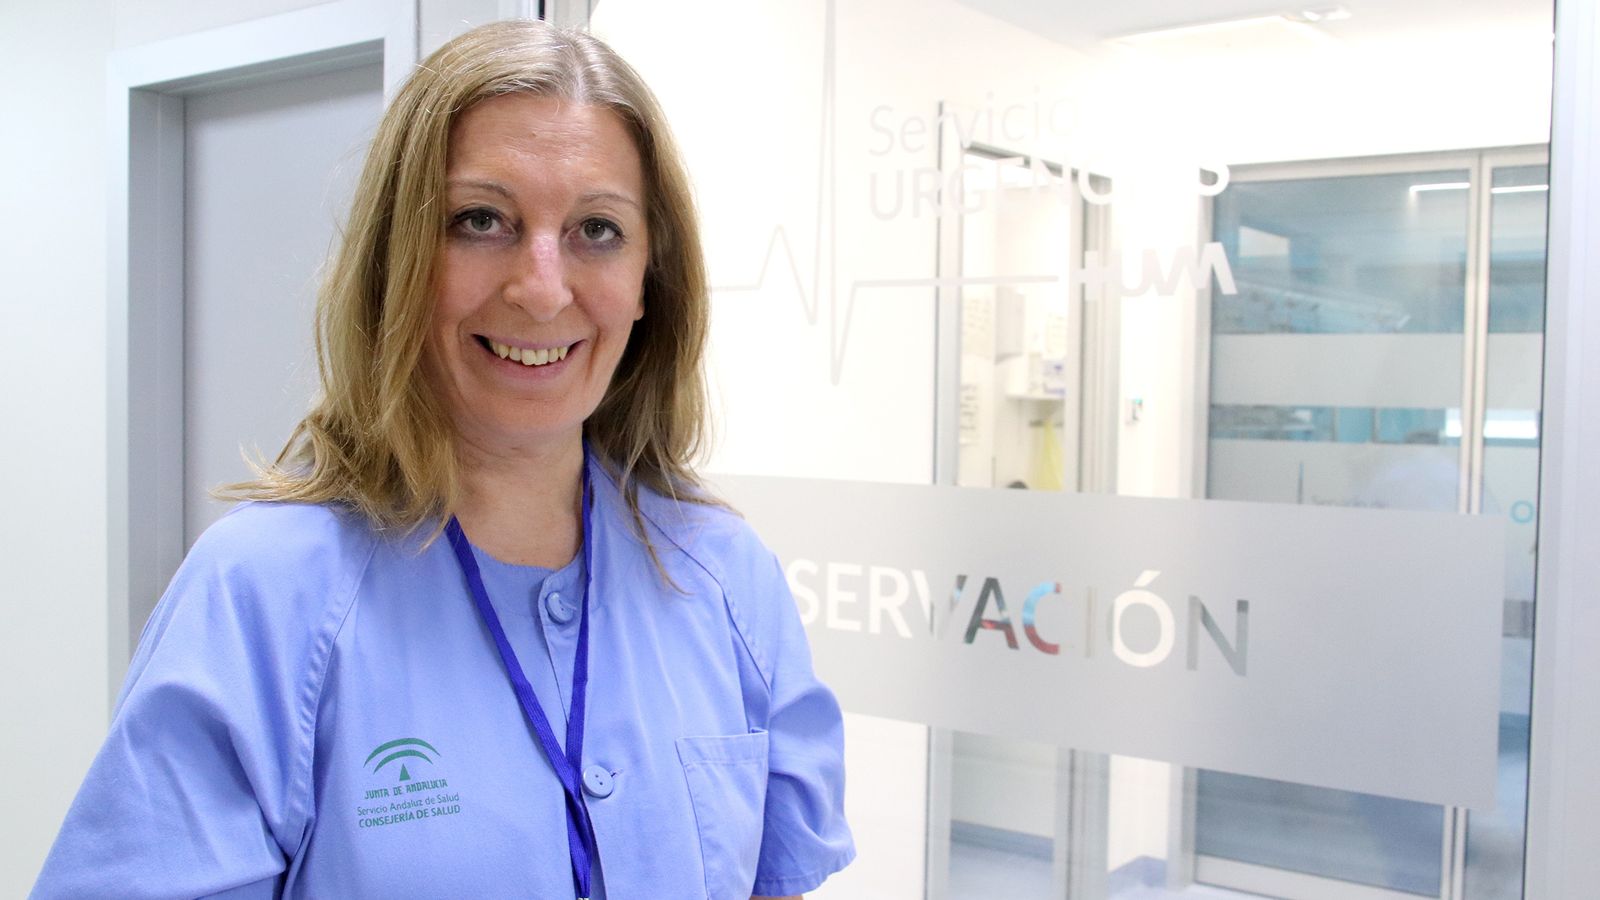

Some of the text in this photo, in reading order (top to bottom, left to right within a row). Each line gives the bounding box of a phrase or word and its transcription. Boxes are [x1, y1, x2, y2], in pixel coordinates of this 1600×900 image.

[869, 152, 1230, 221] URGENCS
[357, 792, 460, 816] Servicio Andaluz de Salud
[365, 788, 389, 800] JUNTA
[393, 785, 402, 796] DE
[359, 804, 460, 828] CONSEJERÍA DE SALUD
